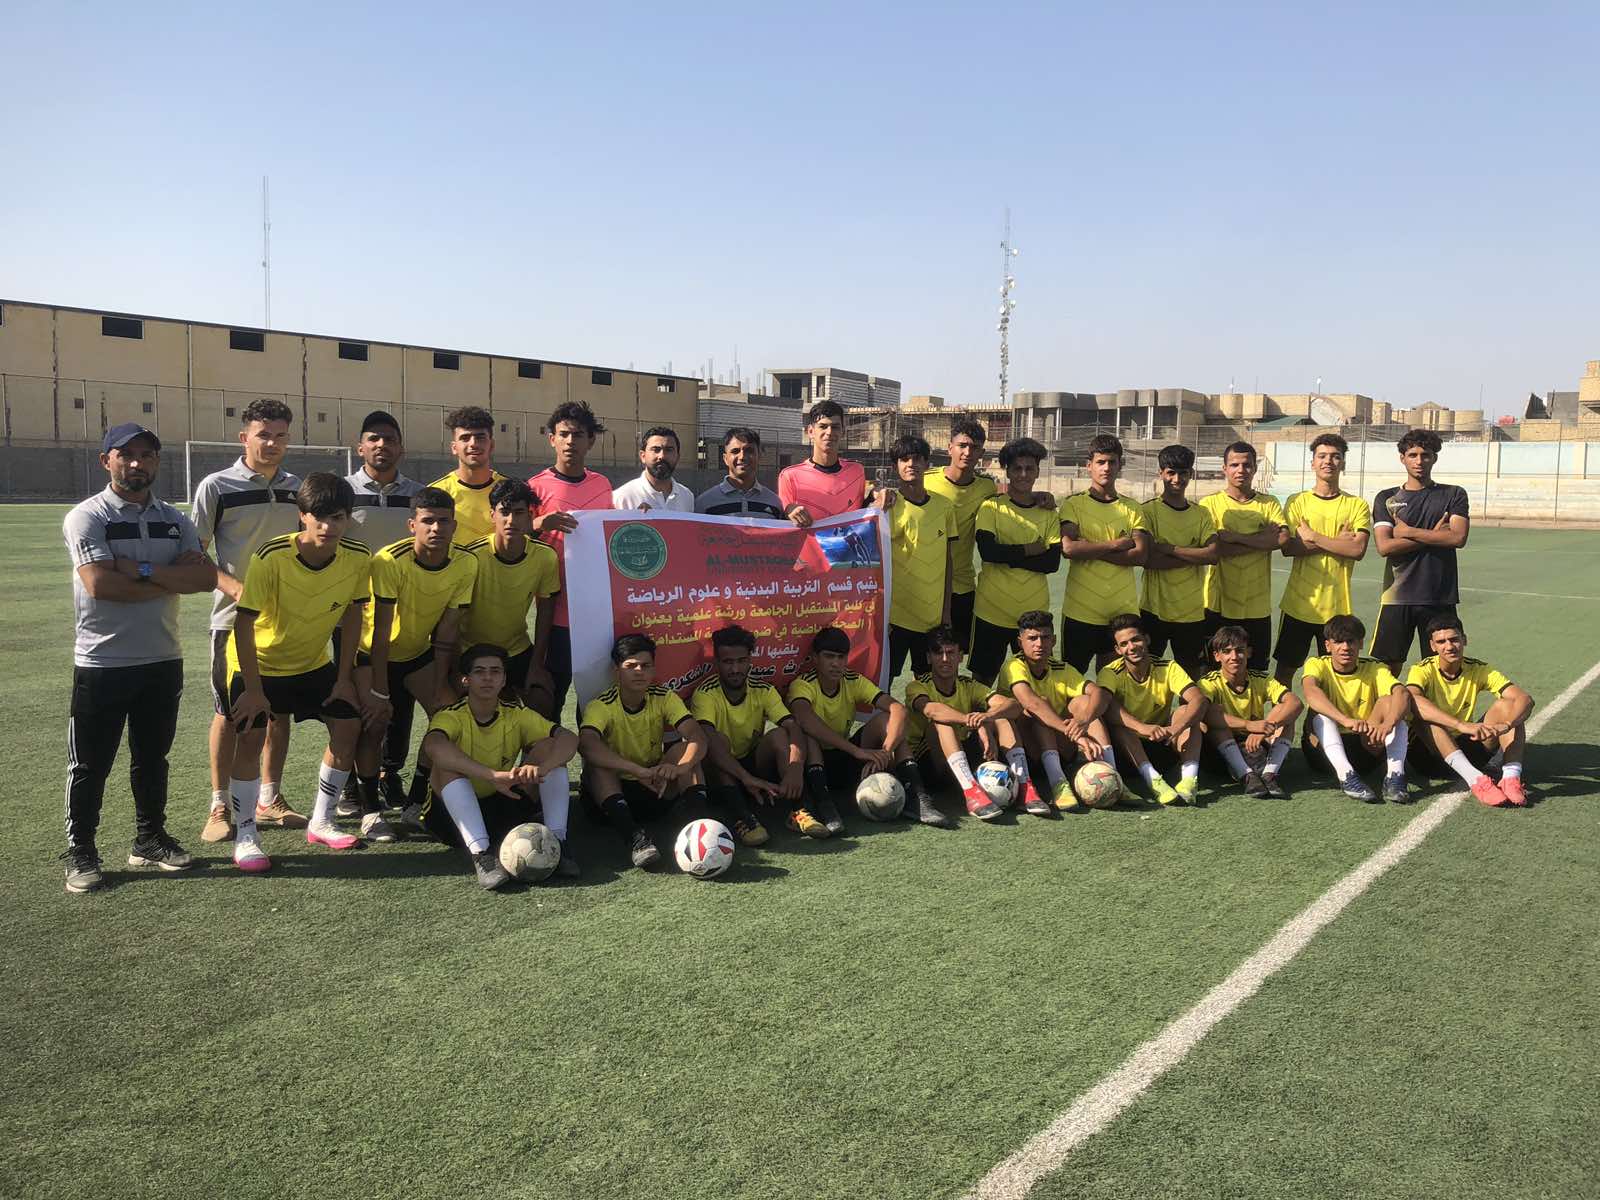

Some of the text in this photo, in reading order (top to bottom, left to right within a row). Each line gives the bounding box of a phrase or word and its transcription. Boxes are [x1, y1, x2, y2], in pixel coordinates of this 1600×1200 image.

[688, 584, 720, 603] علوم
[736, 580, 779, 599] البدنية
[783, 579, 820, 598] التربية
[827, 577, 852, 595] قسم
[856, 577, 878, 594] يقيم
[627, 585, 683, 605] الرياضة
[677, 608, 712, 625] علمية
[715, 605, 746, 620] ورشة
[750, 604, 792, 618] الجامعة
[796, 601, 840, 618] المستقبل
[632, 611, 672, 628] بعنوان
[752, 626, 772, 639] ضو
[775, 627, 788, 641] في
[767, 642, 800, 660] يلقيها
